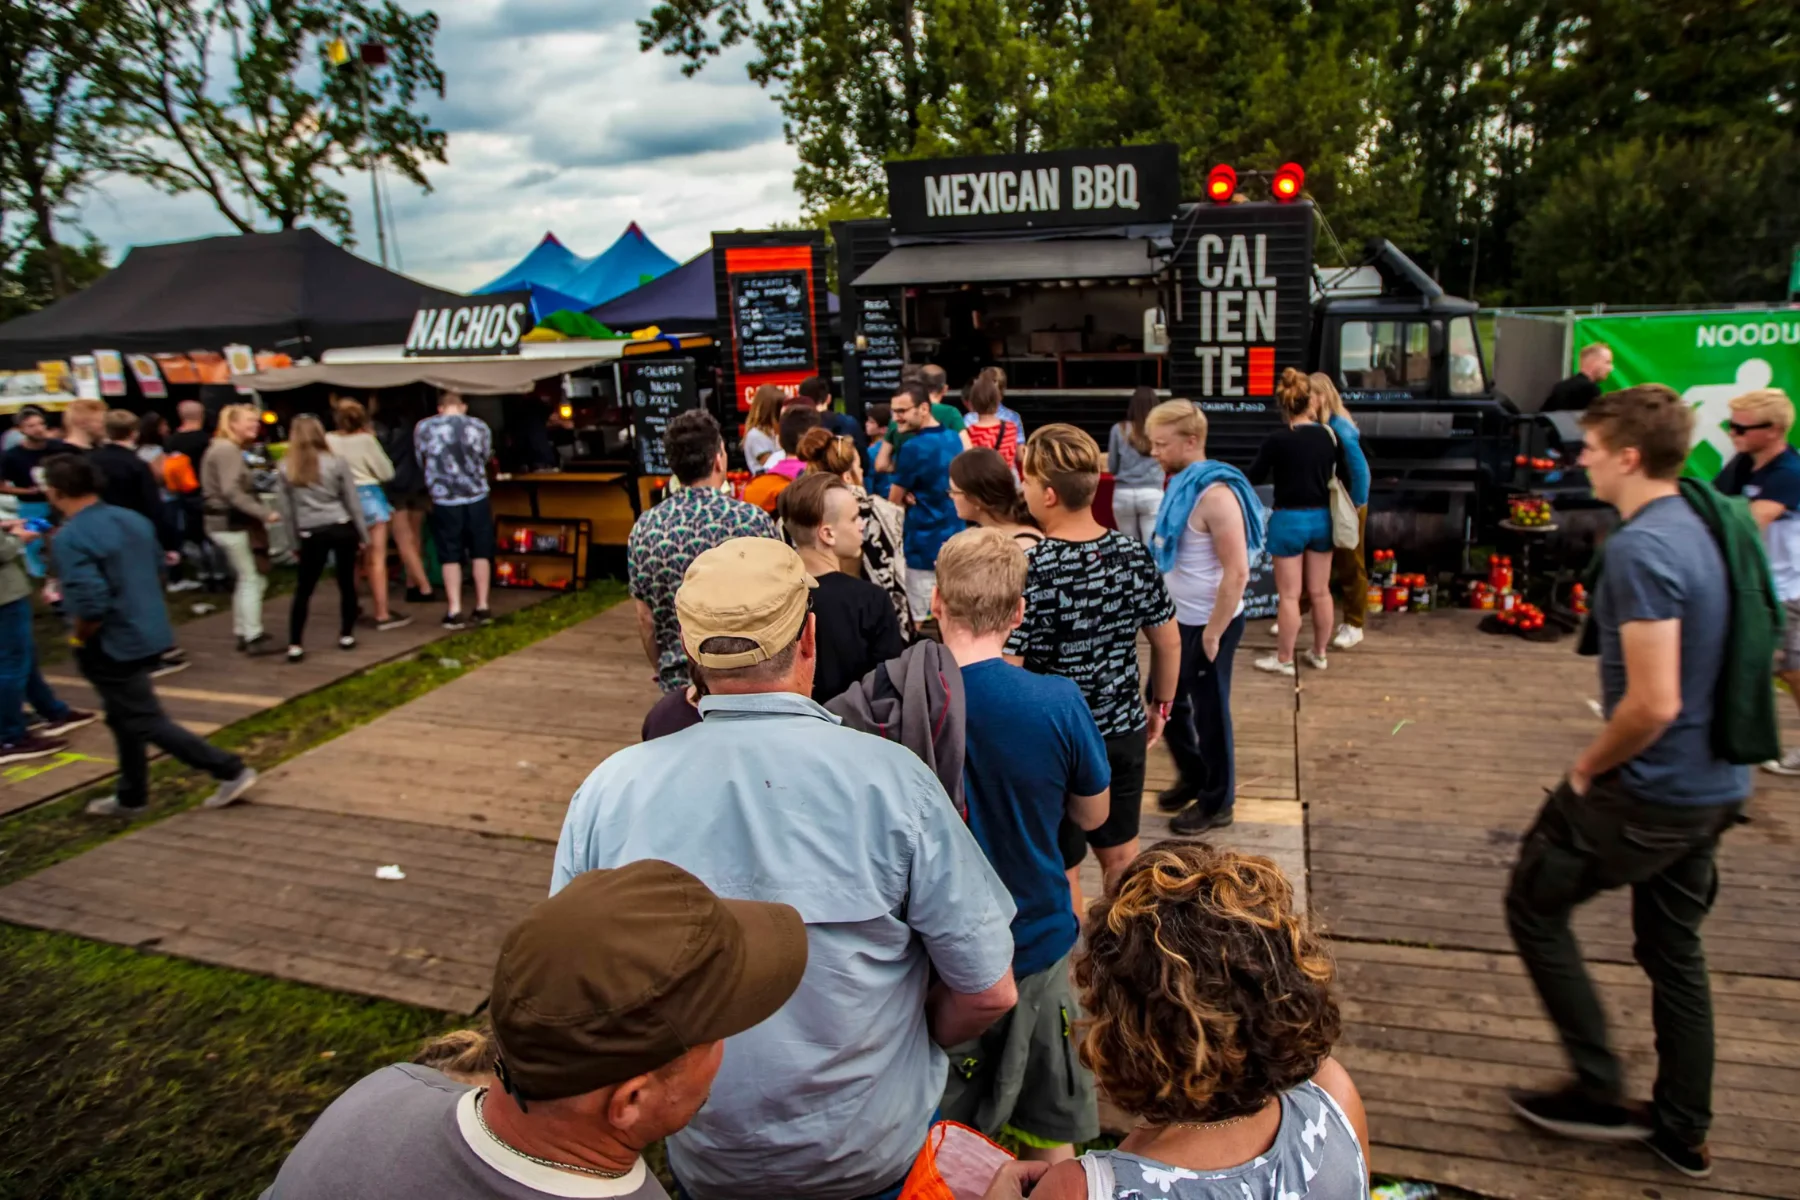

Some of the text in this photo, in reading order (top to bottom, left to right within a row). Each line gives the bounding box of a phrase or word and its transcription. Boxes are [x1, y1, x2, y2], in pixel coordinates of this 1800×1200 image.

[924, 163, 1140, 217] MEXICAN BBQ
[1197, 233, 1277, 288] CAL
[405, 302, 526, 350] NACHOS
[1200, 290, 1277, 342] IEN
[1695, 321, 1800, 348] NOODU
[1194, 346, 1246, 396] TE
